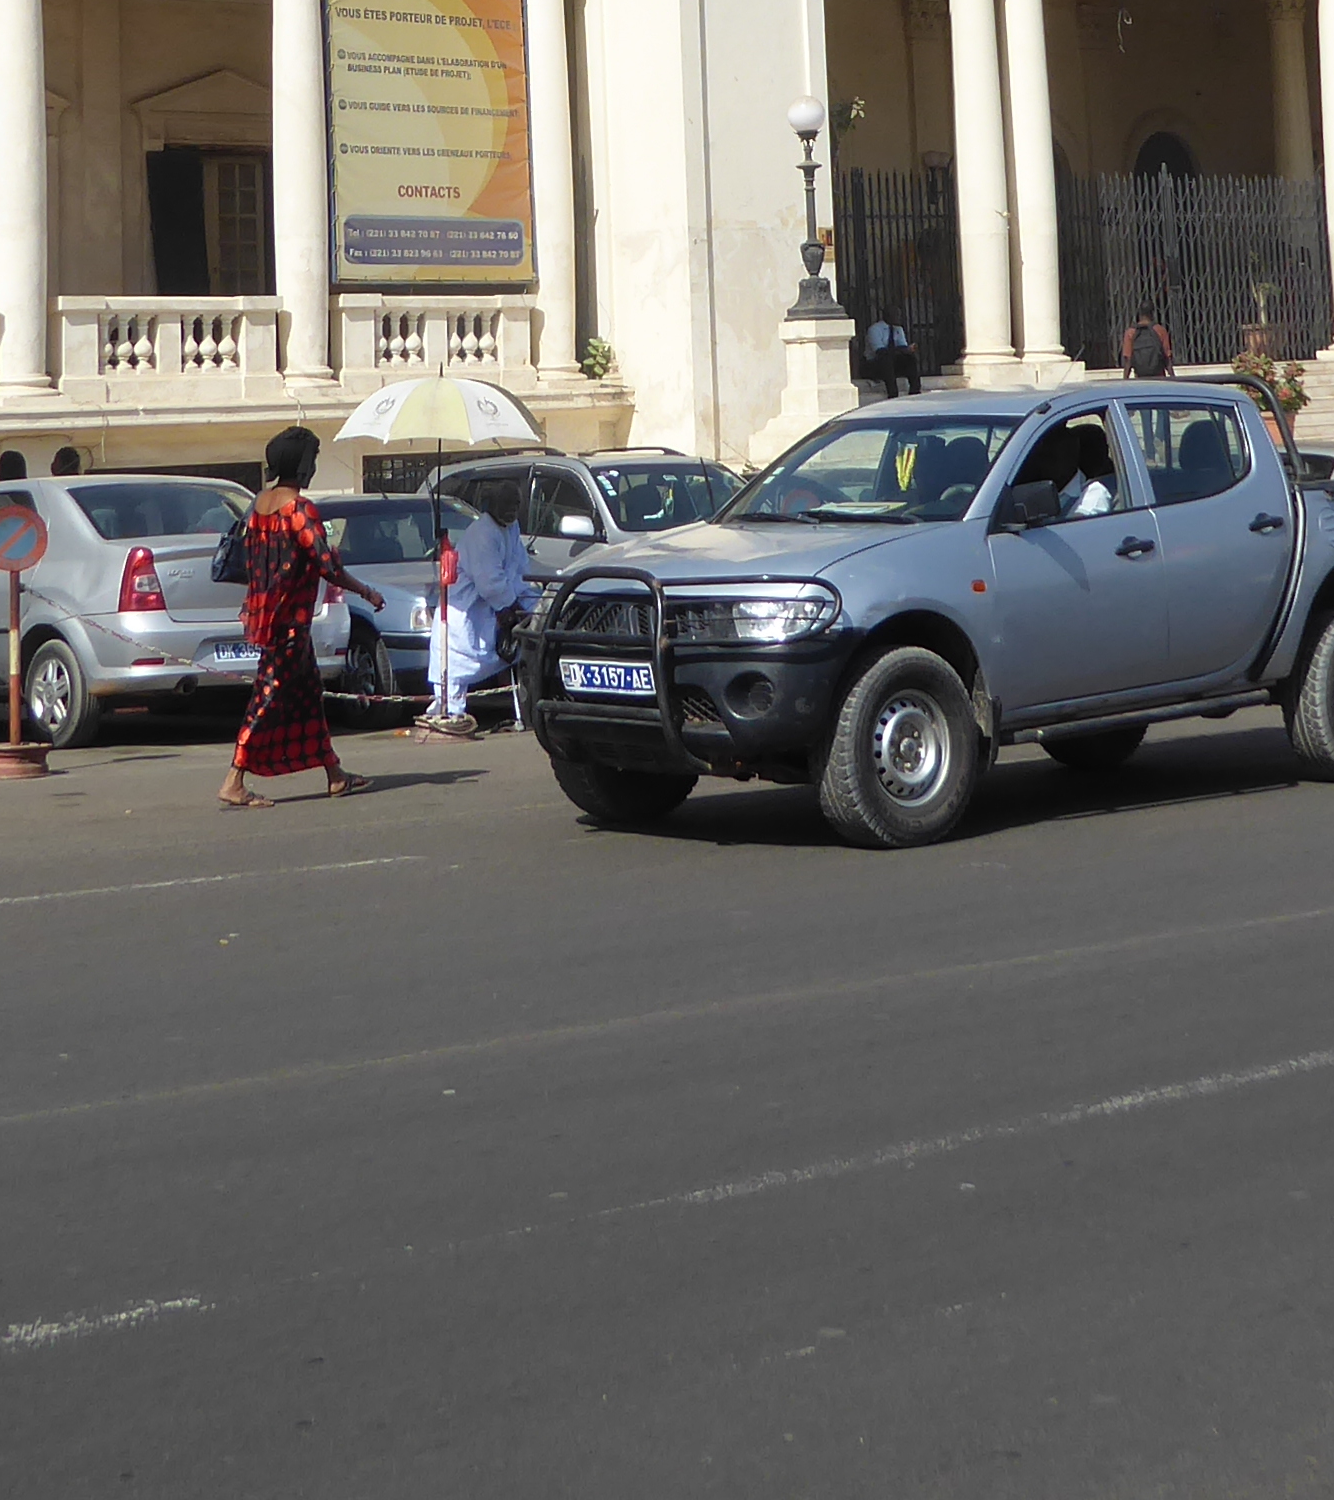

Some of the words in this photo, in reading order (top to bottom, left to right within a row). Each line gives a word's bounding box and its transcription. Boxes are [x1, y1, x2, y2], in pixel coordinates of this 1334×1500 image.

[335, 6, 362, 19] VOUS
[389, 11, 433, 25] PORTEUR
[434, 15, 447, 26] DE
[448, 16, 485, 30] PROJET,
[346, 51, 367, 61] VOUS
[367, 53, 416, 64] ACCOMPAGNE
[416, 55, 436, 66] DANS
[436, 57, 490, 69] L'ELABORATION
[347, 63, 382, 74] BUSINESS
[383, 65, 402, 75] PLAN
[429, 68, 439, 78] DE
[348, 100, 368, 110] VOUS
[368, 102, 391, 112] GUIDE
[392, 103, 411, 113] VERS
[412, 104, 426, 113] LES
[460, 106, 470, 115] DE
[349, 144, 369, 154] VOUS
[402, 147, 421, 156] VERS
[422, 147, 435, 157] LES
[397, 184, 461, 199] CONTACTS
[568, 662, 652, 690] DK-3157-AE
